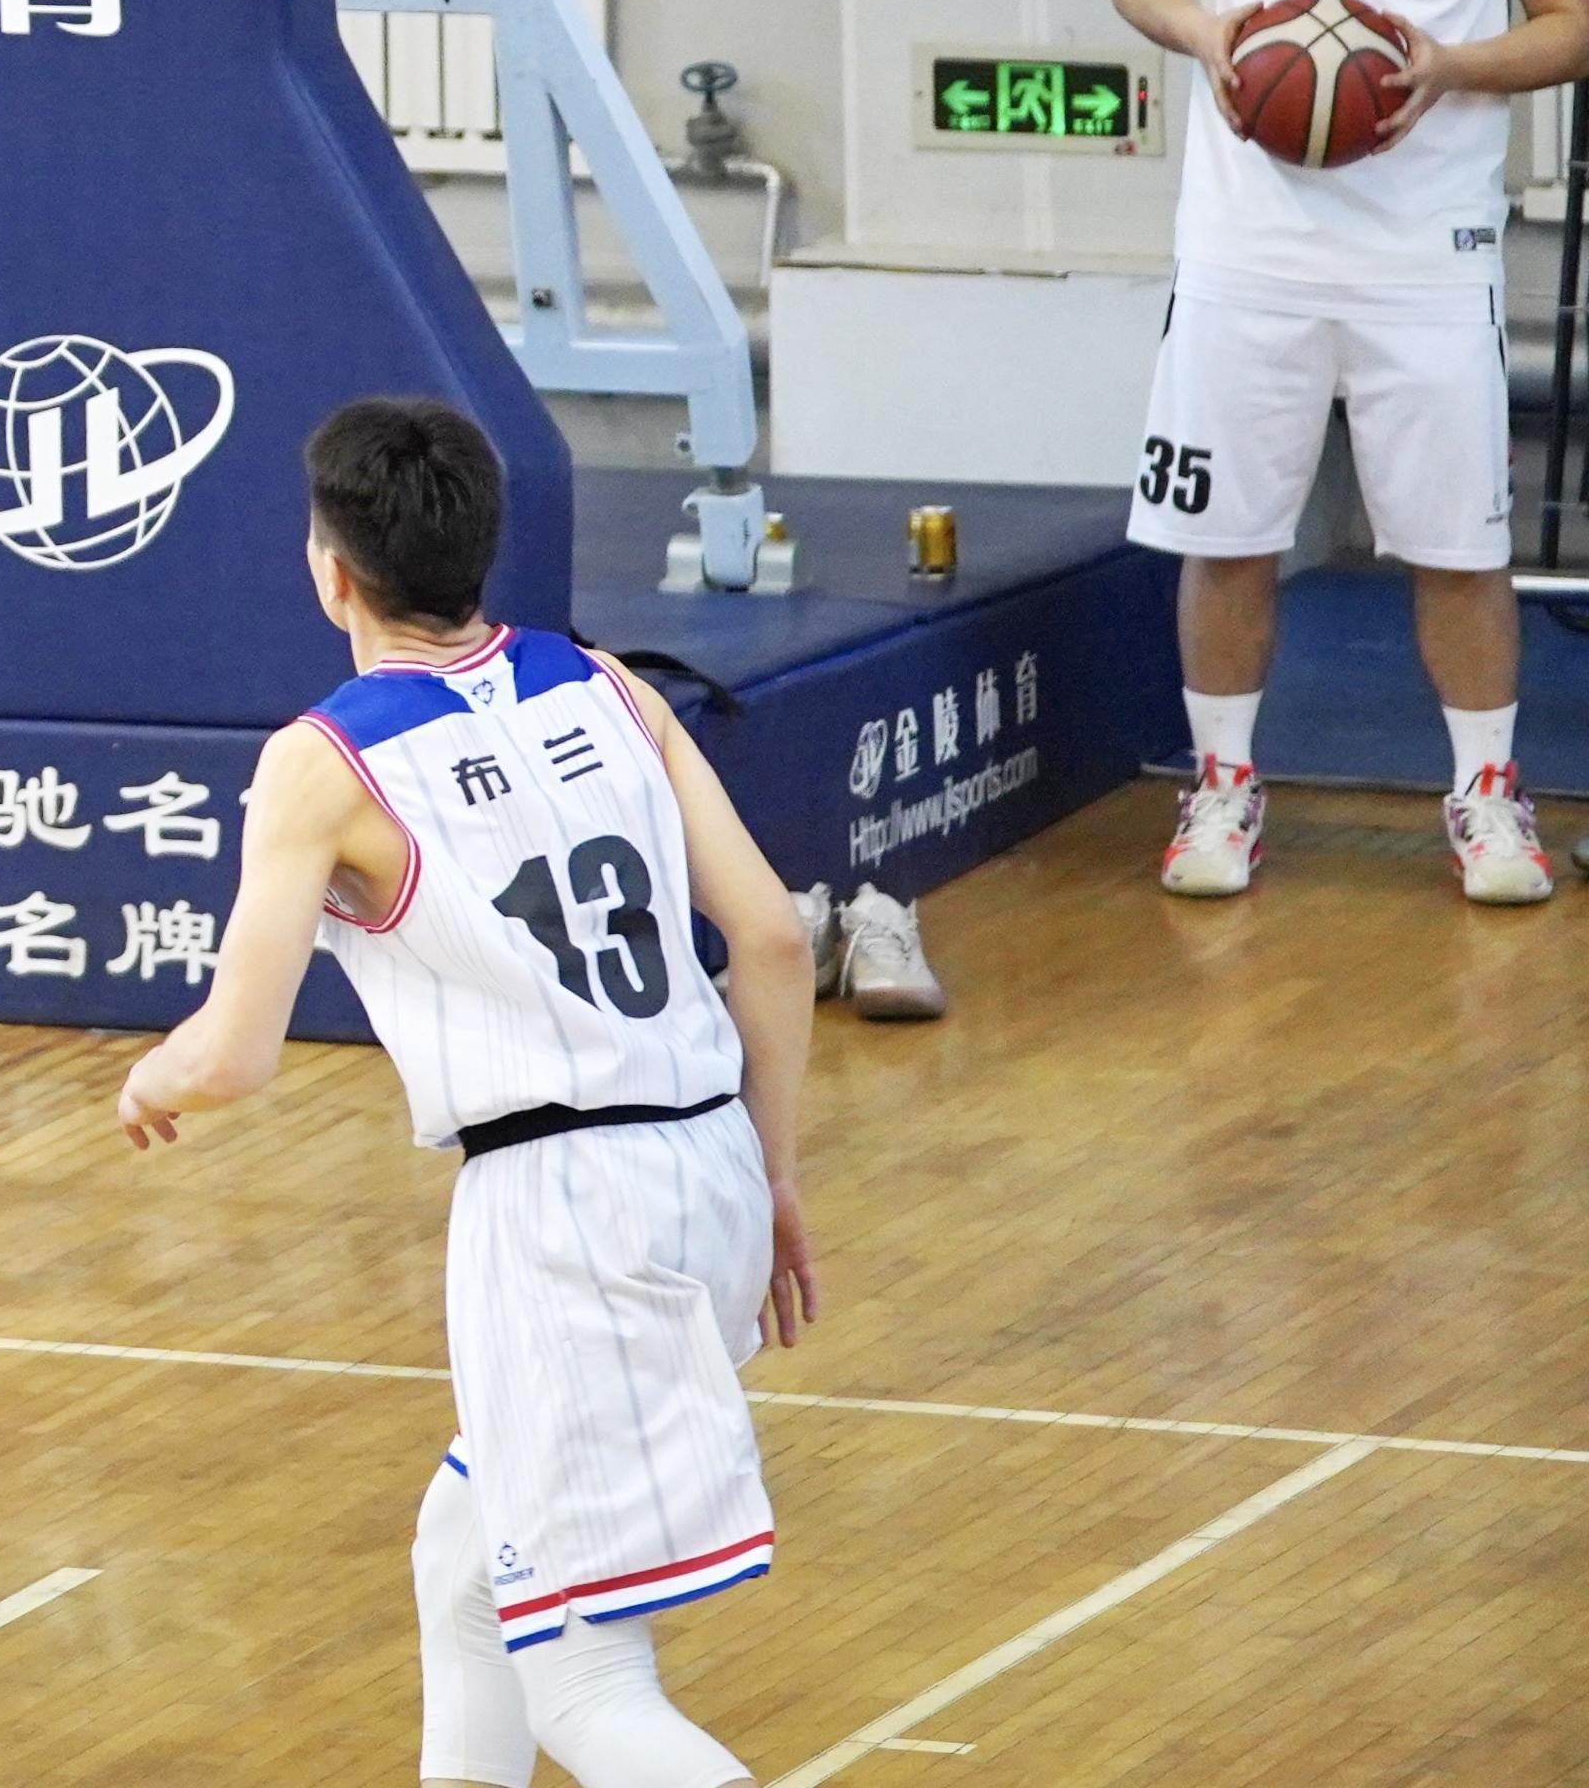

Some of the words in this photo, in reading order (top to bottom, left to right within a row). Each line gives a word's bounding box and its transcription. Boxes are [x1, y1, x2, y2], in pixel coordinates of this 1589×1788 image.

[1137, 435, 1212, 515] 35
[895, 650, 1038, 782] 金陵体育
[493, 834, 670, 1019] 13
